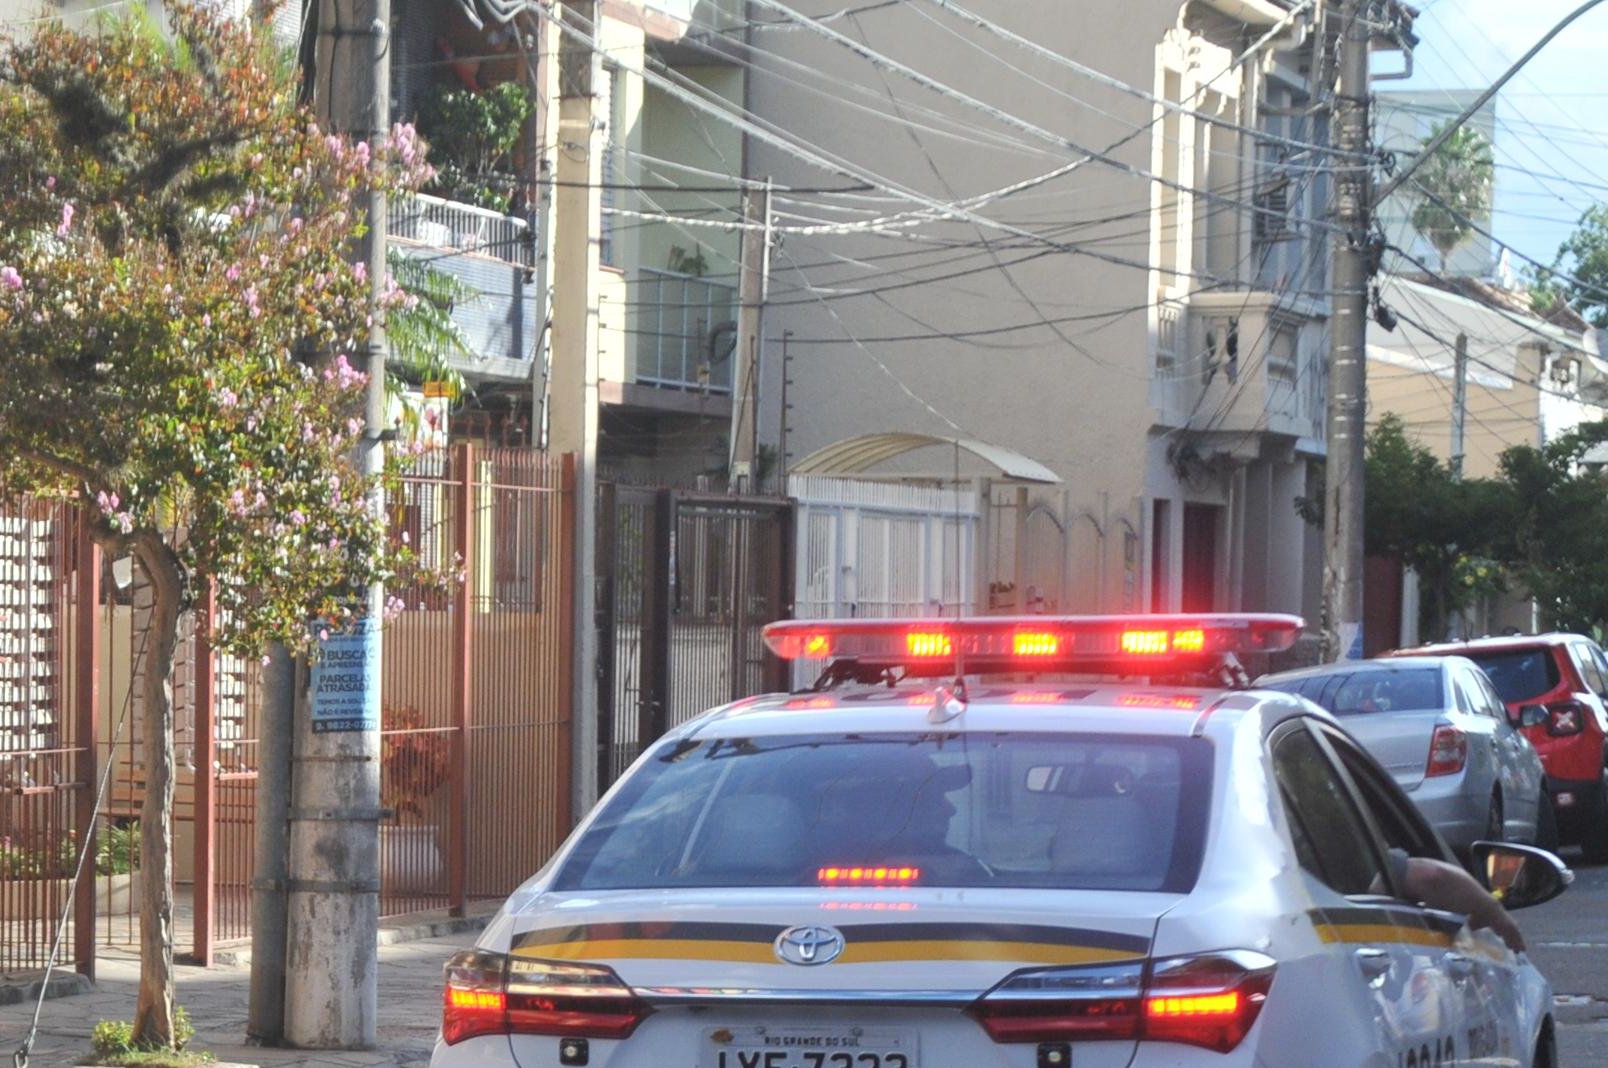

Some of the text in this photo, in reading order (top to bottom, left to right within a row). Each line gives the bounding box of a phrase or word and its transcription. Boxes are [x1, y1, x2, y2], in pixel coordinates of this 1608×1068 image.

[317, 683, 373, 693] ATRASADA
[765, 1036, 860, 1046] RIO GRANDE DO SUL
